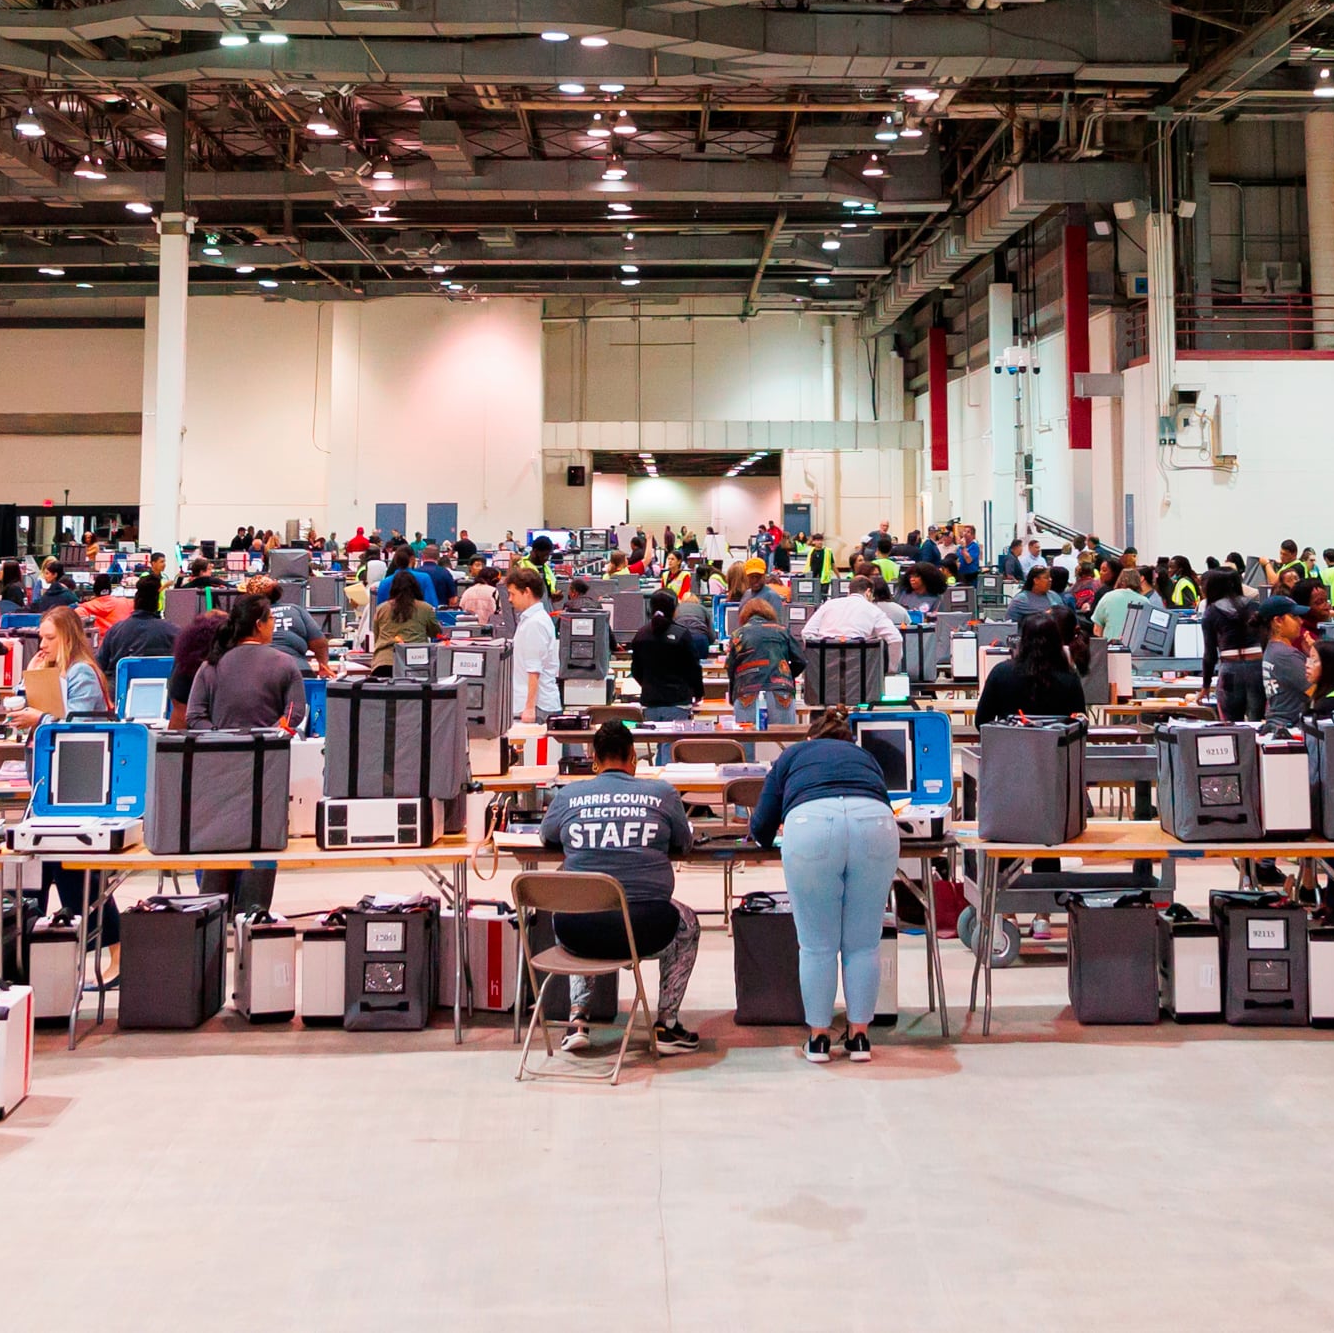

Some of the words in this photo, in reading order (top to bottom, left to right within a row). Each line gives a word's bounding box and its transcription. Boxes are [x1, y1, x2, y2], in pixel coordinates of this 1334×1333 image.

[1206, 747, 1229, 756] 92119
[569, 793, 611, 808] HARRIS
[613, 793, 662, 808] COUNTY
[579, 807, 647, 818] ELECTIONS
[568, 822, 659, 849] STAFF
[1252, 930, 1275, 938] 92115
